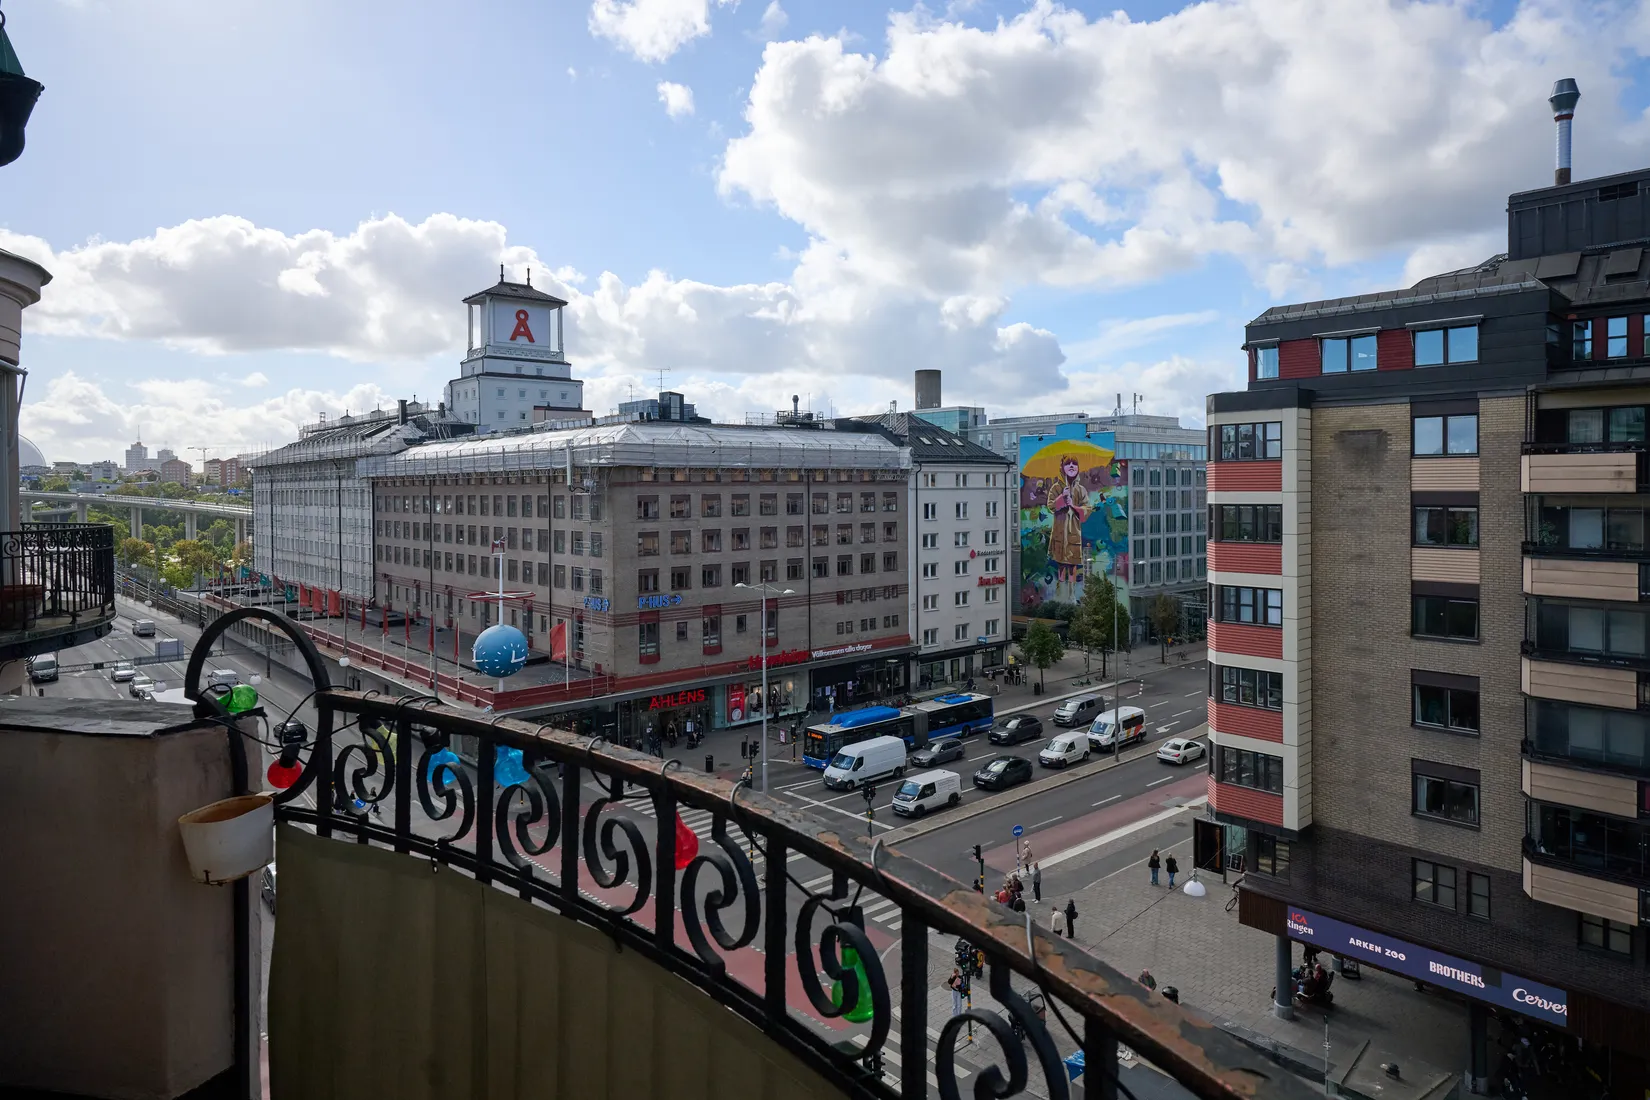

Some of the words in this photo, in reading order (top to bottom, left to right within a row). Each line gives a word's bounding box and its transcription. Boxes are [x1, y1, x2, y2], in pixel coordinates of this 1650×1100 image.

[509, 309, 535, 343] Å
[648, 689, 705, 711] ÅHLÉNS
[1291, 912, 1308, 925] ICA
[1348, 937, 1382, 954] ARKEN
[1384, 948, 1406, 961] ZOO
[1429, 960, 1485, 989] BROTHERS
